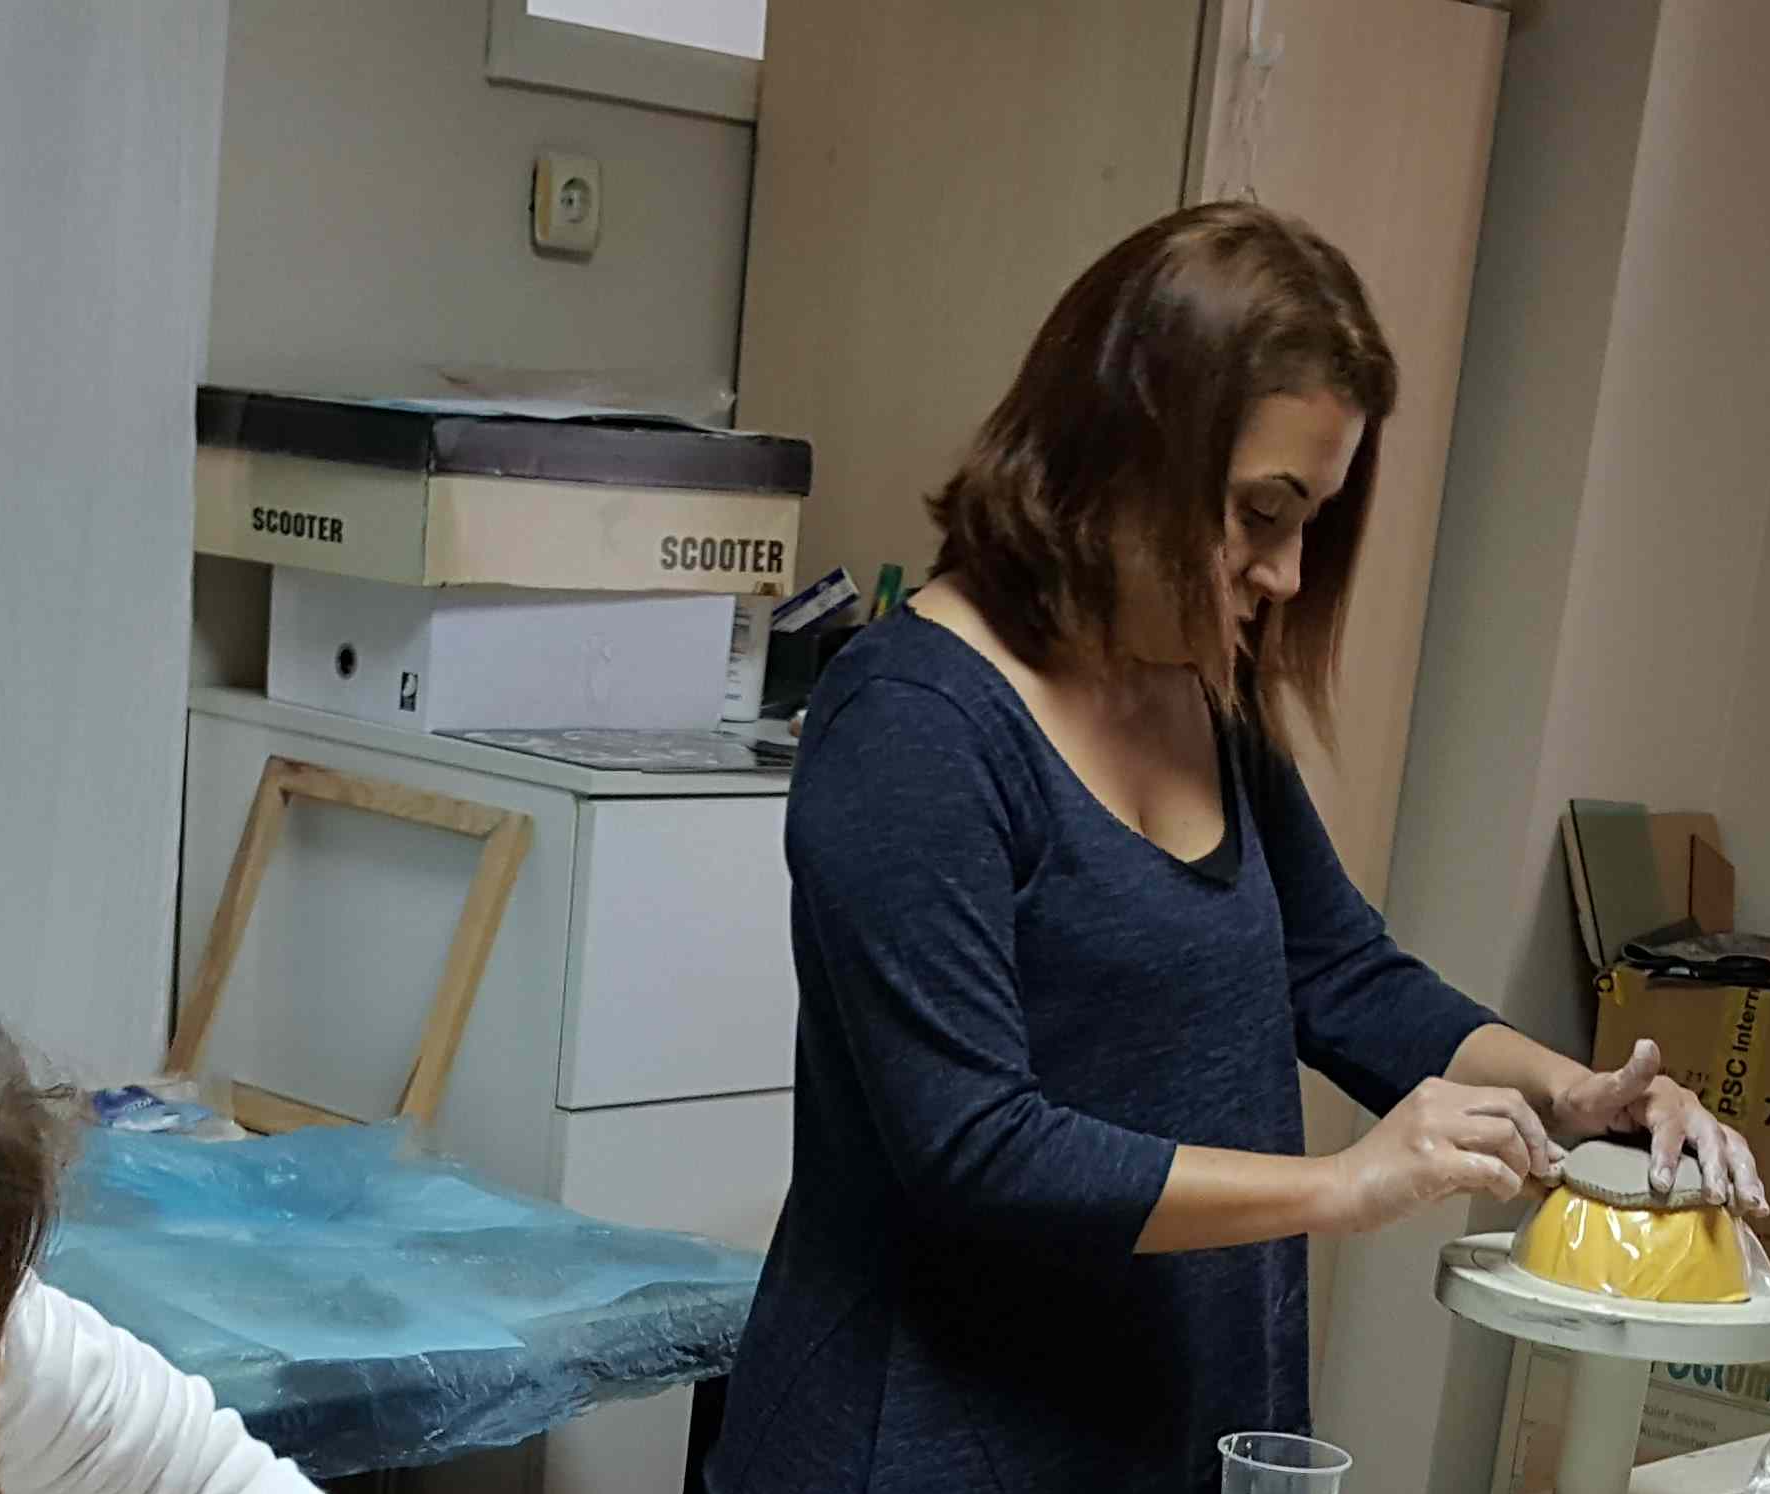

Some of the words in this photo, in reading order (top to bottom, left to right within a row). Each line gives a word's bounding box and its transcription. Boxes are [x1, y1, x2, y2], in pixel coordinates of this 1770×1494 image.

[252, 506, 343, 544] SCOOTER
[660, 535, 783, 573] SCOOTER
[1718, 1058, 1748, 1116] PSC
